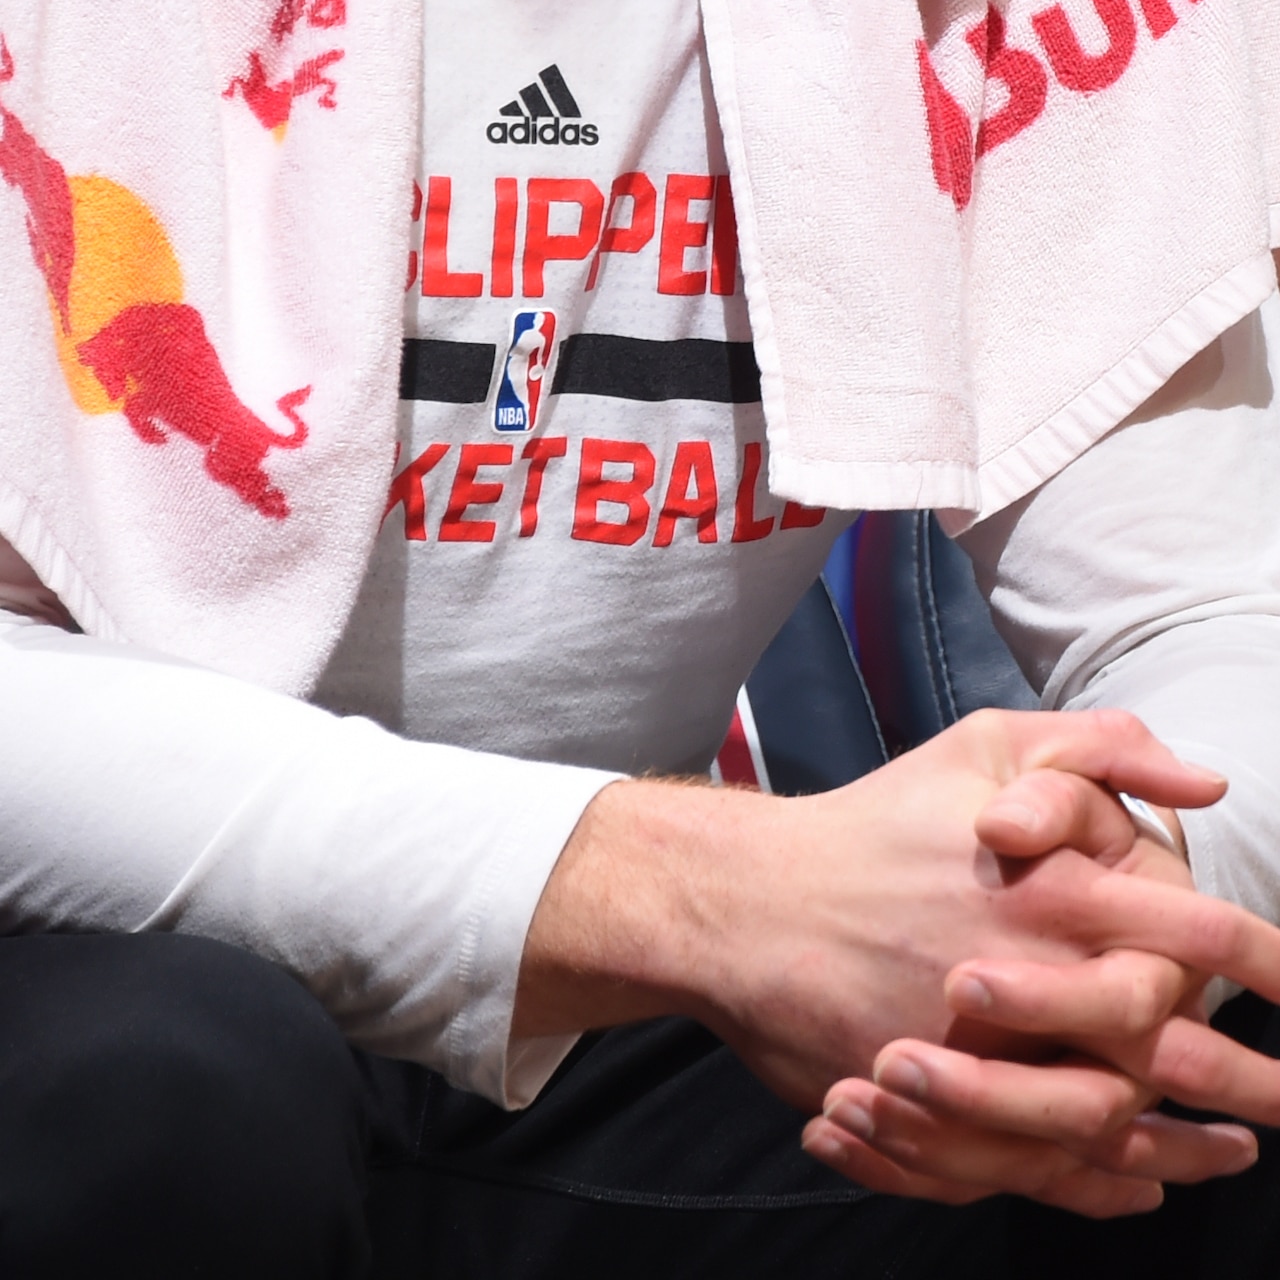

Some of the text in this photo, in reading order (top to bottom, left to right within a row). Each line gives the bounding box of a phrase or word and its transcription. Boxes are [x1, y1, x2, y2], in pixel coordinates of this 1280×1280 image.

[486, 116, 599, 147] adidas
[405, 171, 738, 298] LIPPE
[498, 407, 525, 426] NBA
